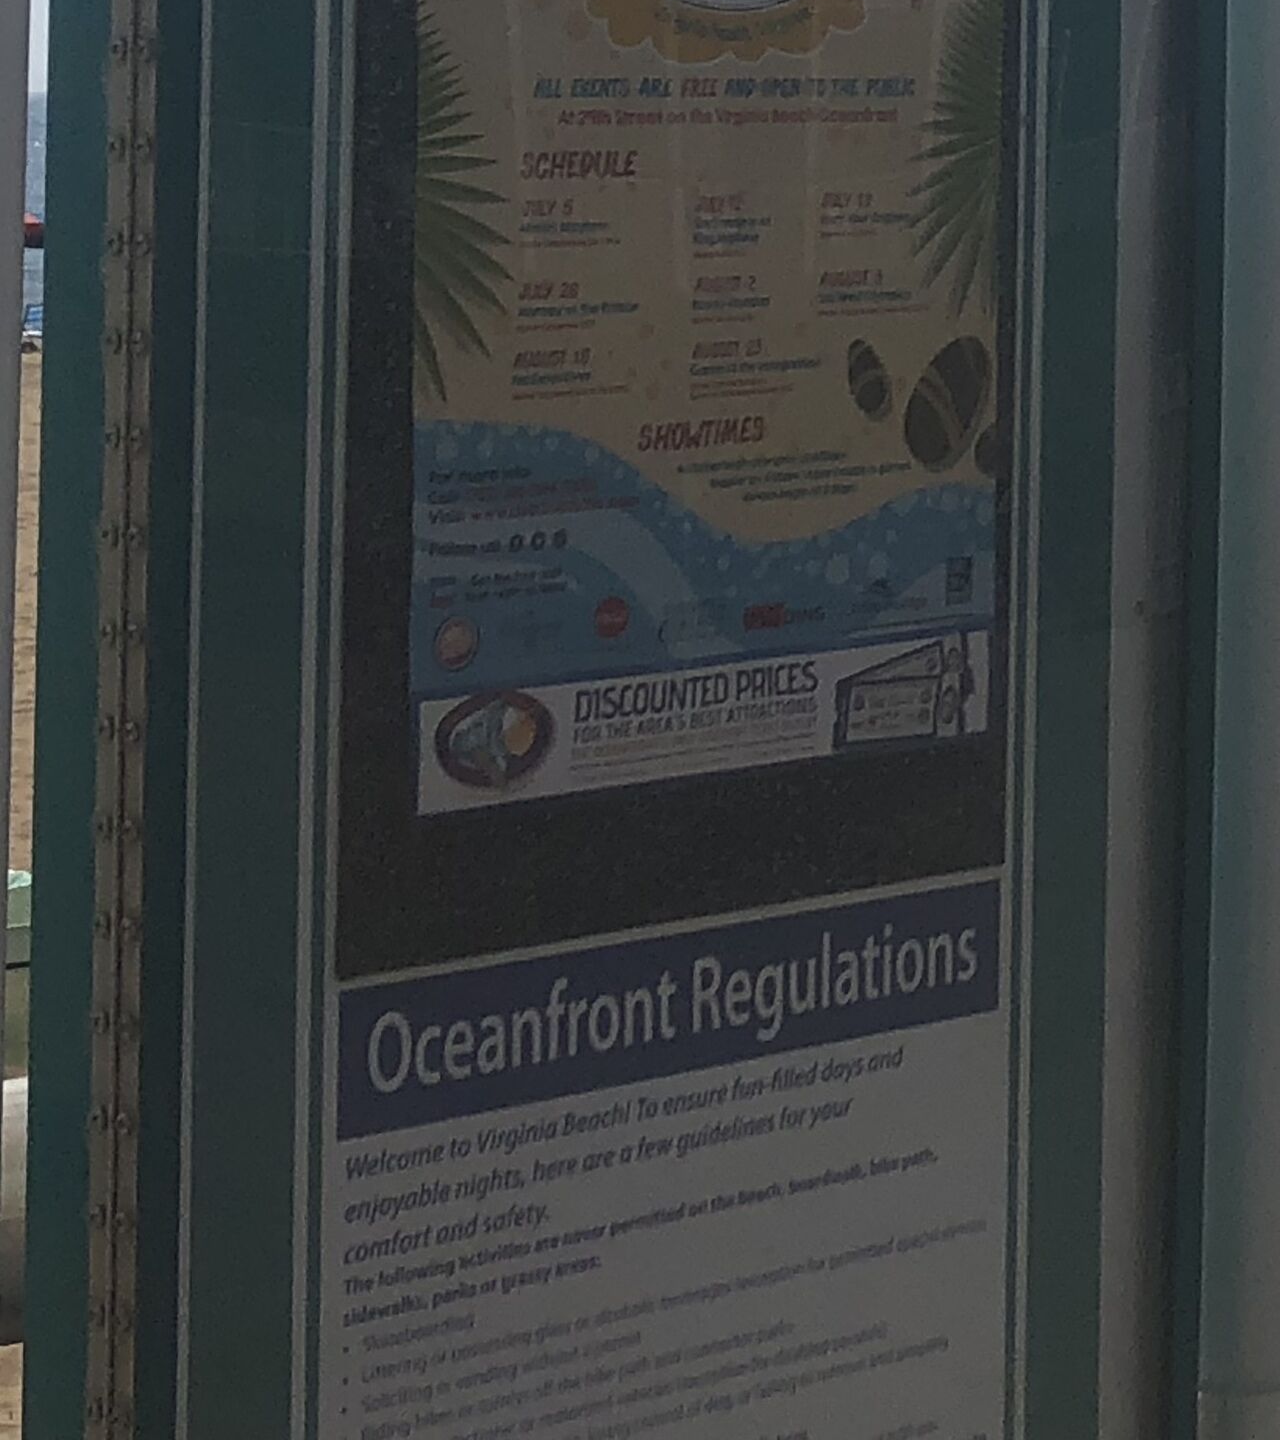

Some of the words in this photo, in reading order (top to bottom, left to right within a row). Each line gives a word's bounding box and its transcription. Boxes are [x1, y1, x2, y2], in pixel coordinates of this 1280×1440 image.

[533, 77, 562, 99] ALL
[570, 77, 631, 98] EVENTS
[638, 76, 673, 98] ARE
[680, 77, 718, 98] FREE
[724, 77, 756, 99] AND
[520, 149, 639, 180] SCHEDULE
[636, 414, 765, 453] SHOWTIMES
[573, 672, 730, 724] DISCOUNTED
[734, 660, 819, 702] PRICES
[572, 723, 602, 745] FOR
[606, 719, 633, 740] THE
[367, 970, 678, 1094] Oceanfront
[692, 923, 978, 1043] Regulations
[345, 1142, 445, 1181] Welcome
[449, 1136, 472, 1159] to
[476, 1120, 559, 1156] Virginia
[561, 1098, 632, 1137] Beach!
[636, 1096, 659, 1122] To
[662, 1081, 728, 1115] ensure
[731, 1061, 819, 1103] fun-filled
[821, 1056, 865, 1084] days
[867, 1045, 905, 1073] and
[344, 1179, 451, 1226] enjoyable
[454, 1167, 526, 1204] nights,
[531, 1155, 578, 1183] here
[581, 1149, 614, 1174] are
[619, 1144, 634, 1161] a
[635, 1135, 674, 1162] few
[676, 1111, 776, 1160] guidelines
[778, 1103, 807, 1132] for
[808, 1096, 855, 1130] your
[342, 1276, 375, 1296] The
[377, 1259, 456, 1289] following
[458, 1242, 532, 1271] activities
[533, 1234, 558, 1254] are
[688, 1198, 709, 1218] on
[709, 1193, 736, 1212] the
[343, 1223, 433, 1266] comfort
[435, 1212, 479, 1247] and
[481, 1203, 551, 1235] safety.
[431, 1280, 477, 1310] parks
[479, 1278, 498, 1295] or
